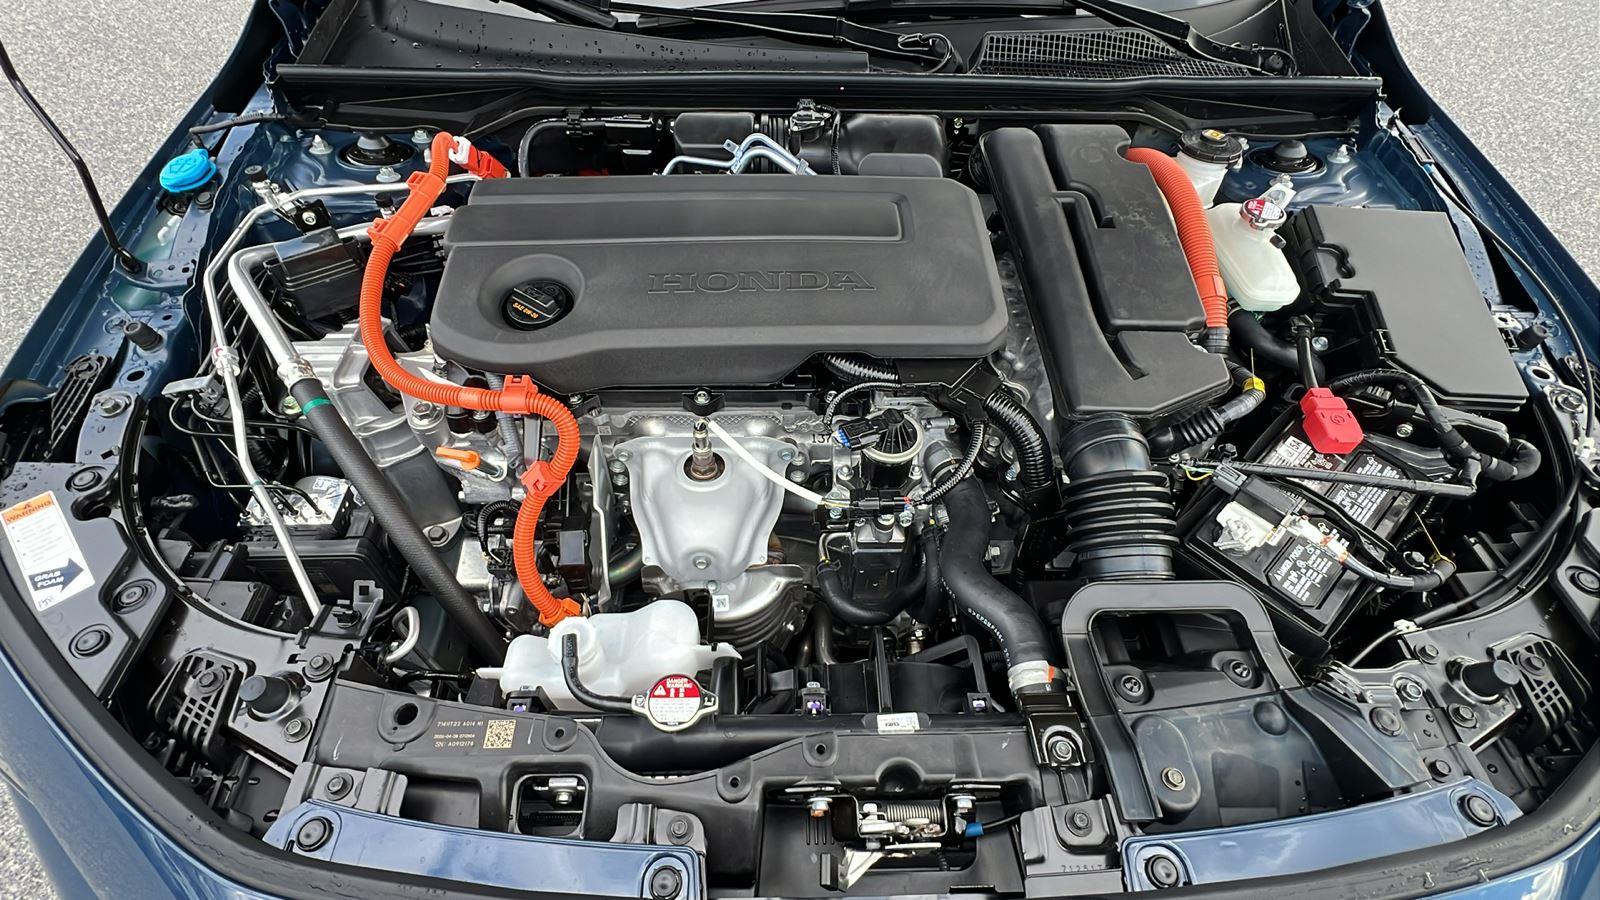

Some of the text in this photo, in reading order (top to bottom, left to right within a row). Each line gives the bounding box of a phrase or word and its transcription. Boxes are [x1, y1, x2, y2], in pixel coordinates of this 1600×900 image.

[648, 270, 877, 294] HONDA
[6, 500, 52, 522] WARNING
[34, 571, 61, 582] GRAB
[37, 576, 64, 588] FOAM
